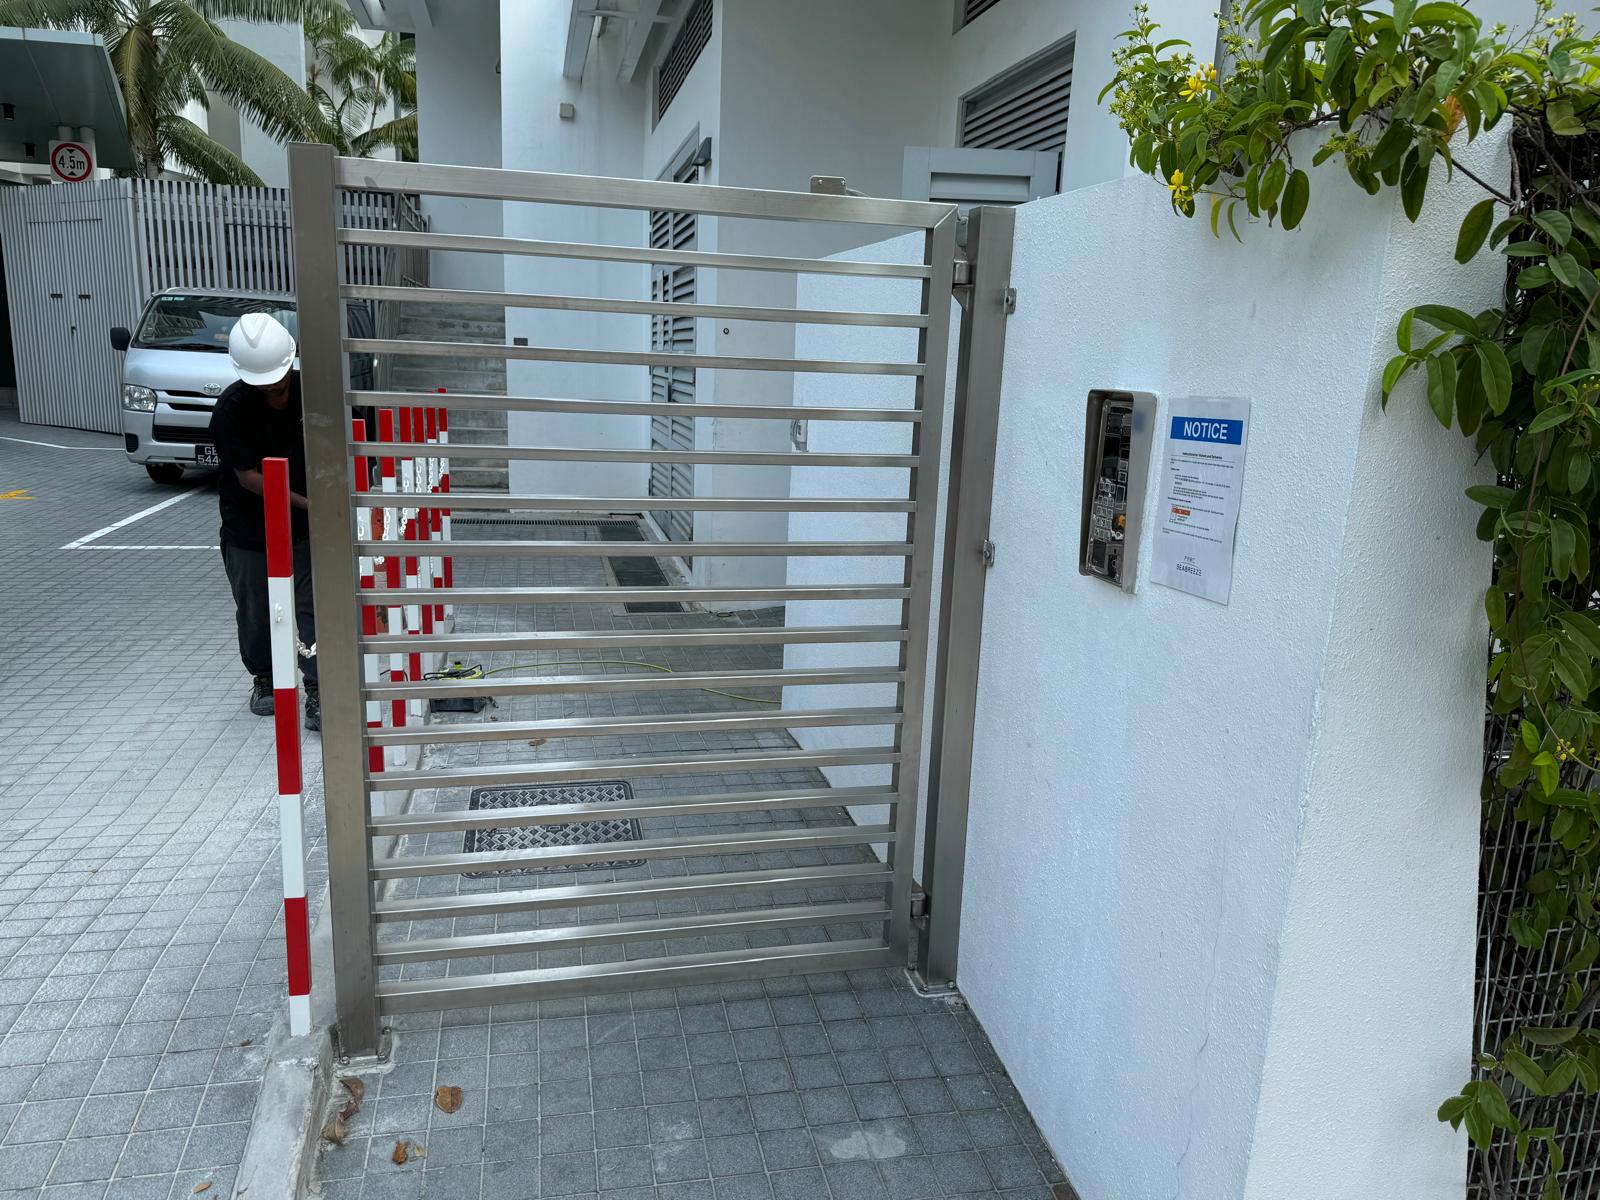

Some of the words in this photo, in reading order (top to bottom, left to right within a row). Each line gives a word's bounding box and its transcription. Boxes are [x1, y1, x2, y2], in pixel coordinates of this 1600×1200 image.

[58, 154, 85, 170] 4.5m
[1183, 421, 1228, 440] NOTICE
[197, 455, 221, 464] 544
